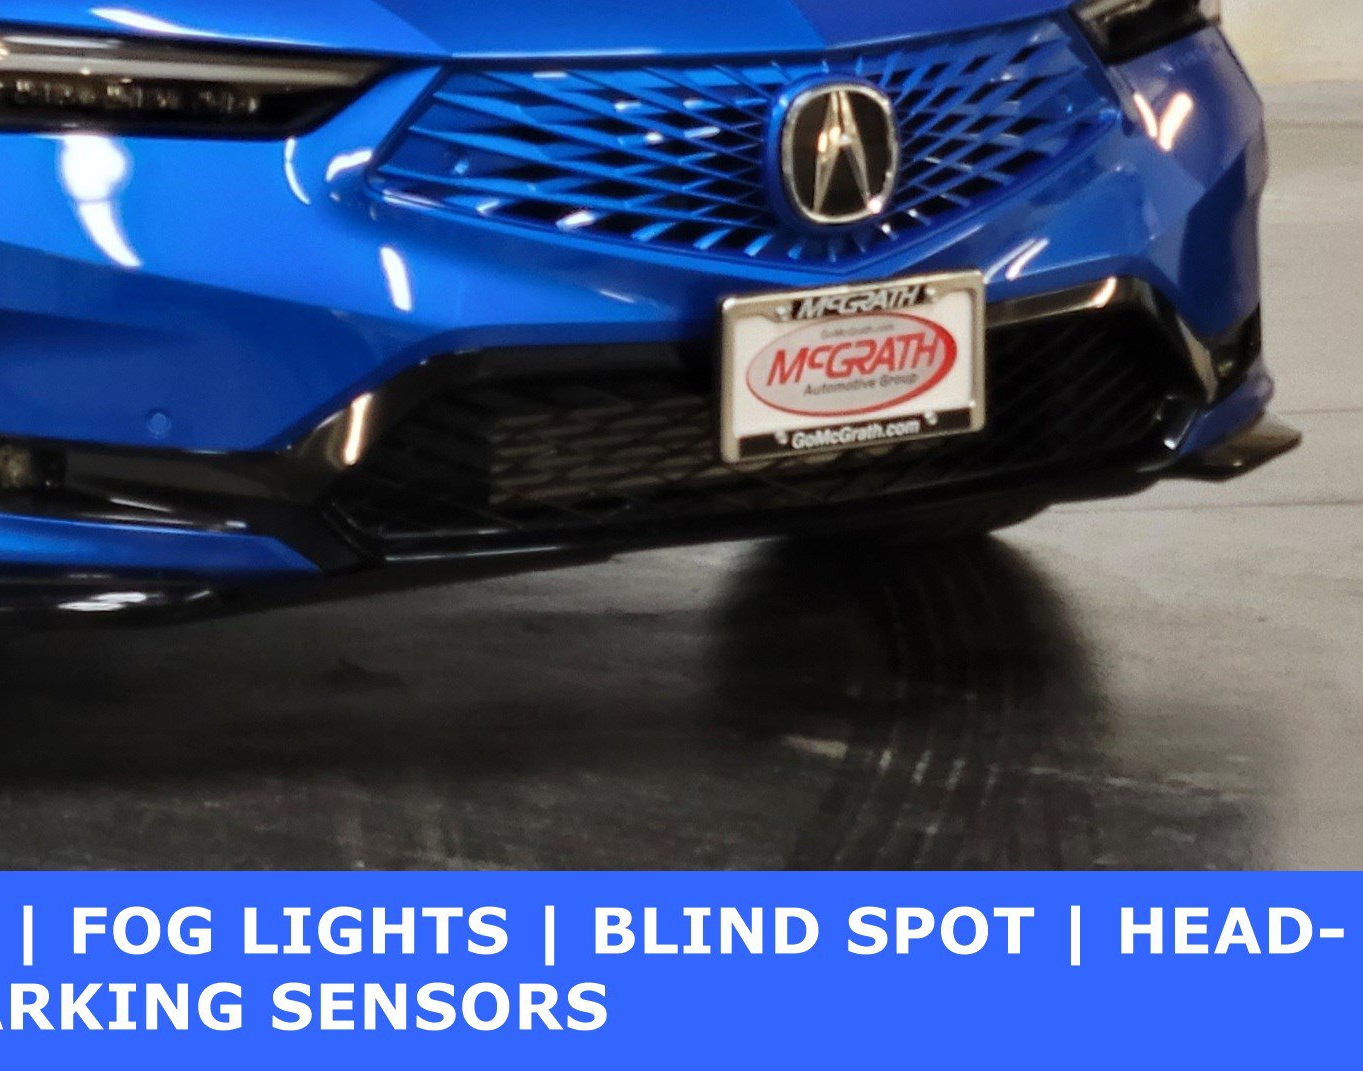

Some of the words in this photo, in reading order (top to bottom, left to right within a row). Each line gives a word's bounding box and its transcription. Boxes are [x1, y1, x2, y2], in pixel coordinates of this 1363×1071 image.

[766, 332, 939, 387] McGRATH
[803, 379, 876, 397] Automotive
[879, 373, 919, 390] Group
[792, 419, 921, 450] GoMcGrath.com
